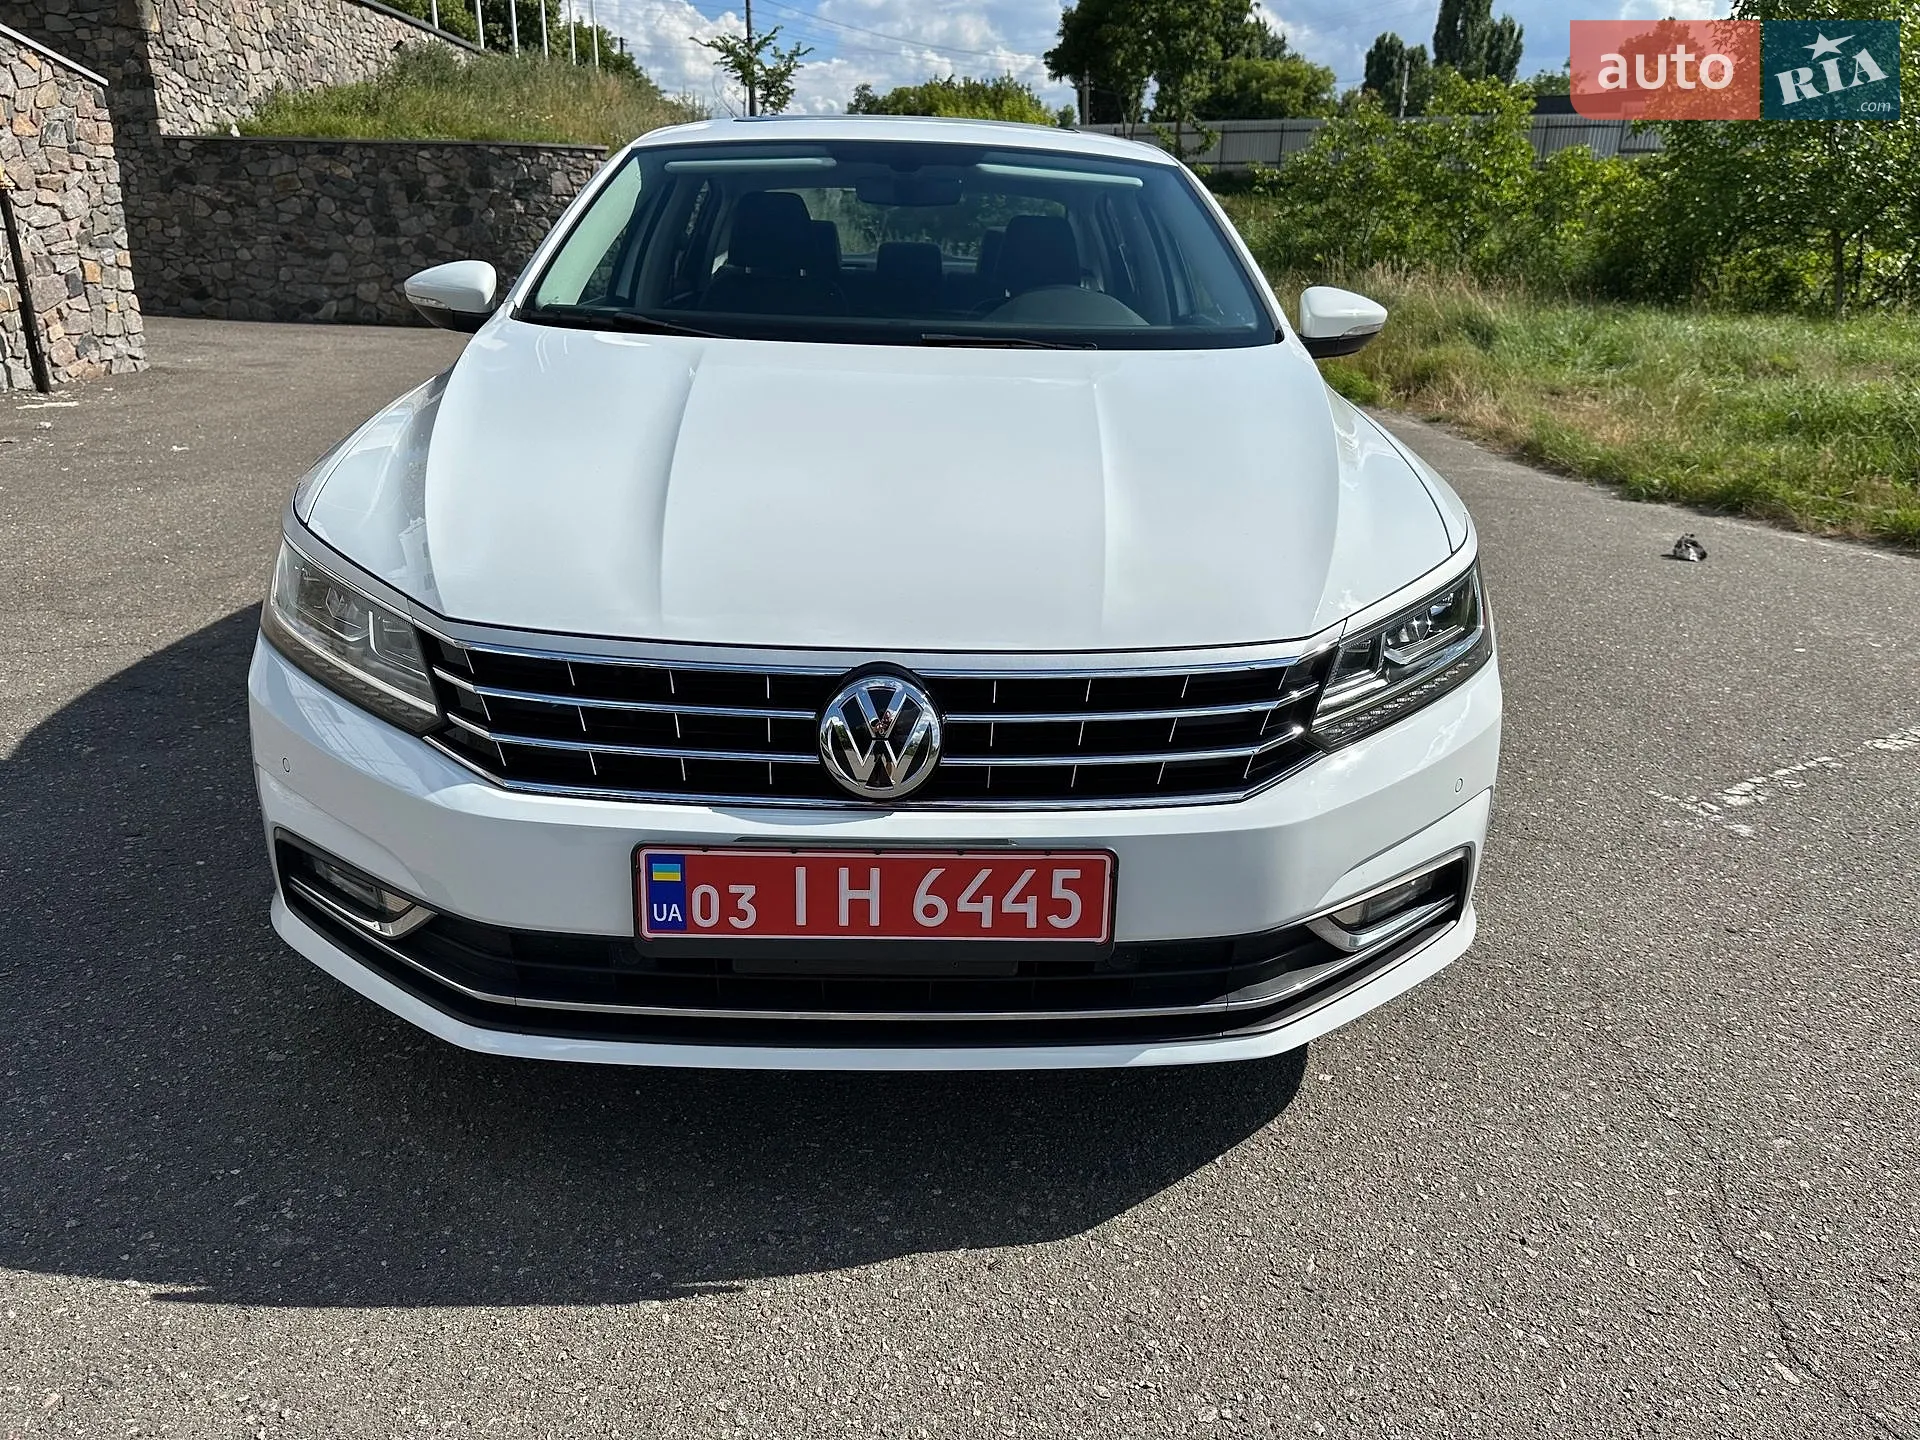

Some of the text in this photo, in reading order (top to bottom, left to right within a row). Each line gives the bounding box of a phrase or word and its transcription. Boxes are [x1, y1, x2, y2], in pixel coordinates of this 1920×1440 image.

[653, 903, 683, 922] UA
[691, 884, 757, 929] 03
[912, 868, 1082, 929] 6445
